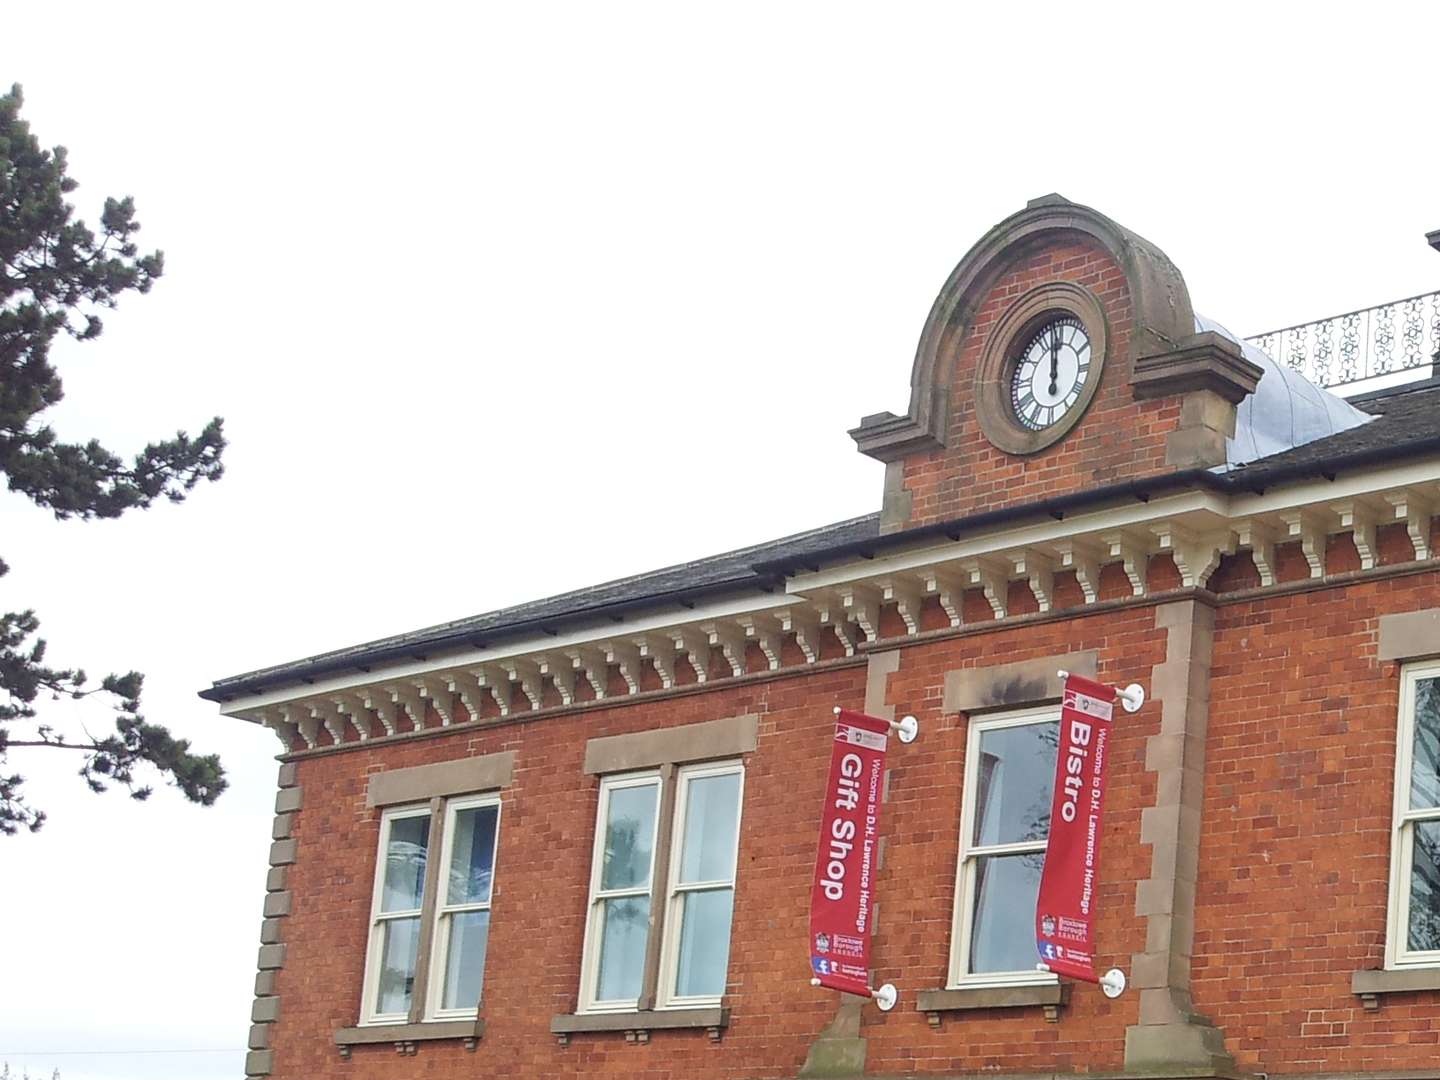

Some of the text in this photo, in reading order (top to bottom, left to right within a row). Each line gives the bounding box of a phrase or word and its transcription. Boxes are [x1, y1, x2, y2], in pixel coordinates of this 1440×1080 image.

[1062, 720, 1091, 822] Bistro
[1094, 728, 1107, 774] Welcome
[868, 759, 881, 803] Welcome
[1090, 789, 1101, 811] D.H.
[1092, 777, 1101, 787] to
[820, 753, 862, 900] Gift Shop
[865, 816, 876, 837] D.H.
[867, 804, 876, 814] to
[1085, 815, 1098, 866] Lawrence
[861, 840, 874, 888] Lawrence
[856, 889, 870, 933] Heritage
[1081, 868, 1094, 914] Heritage
